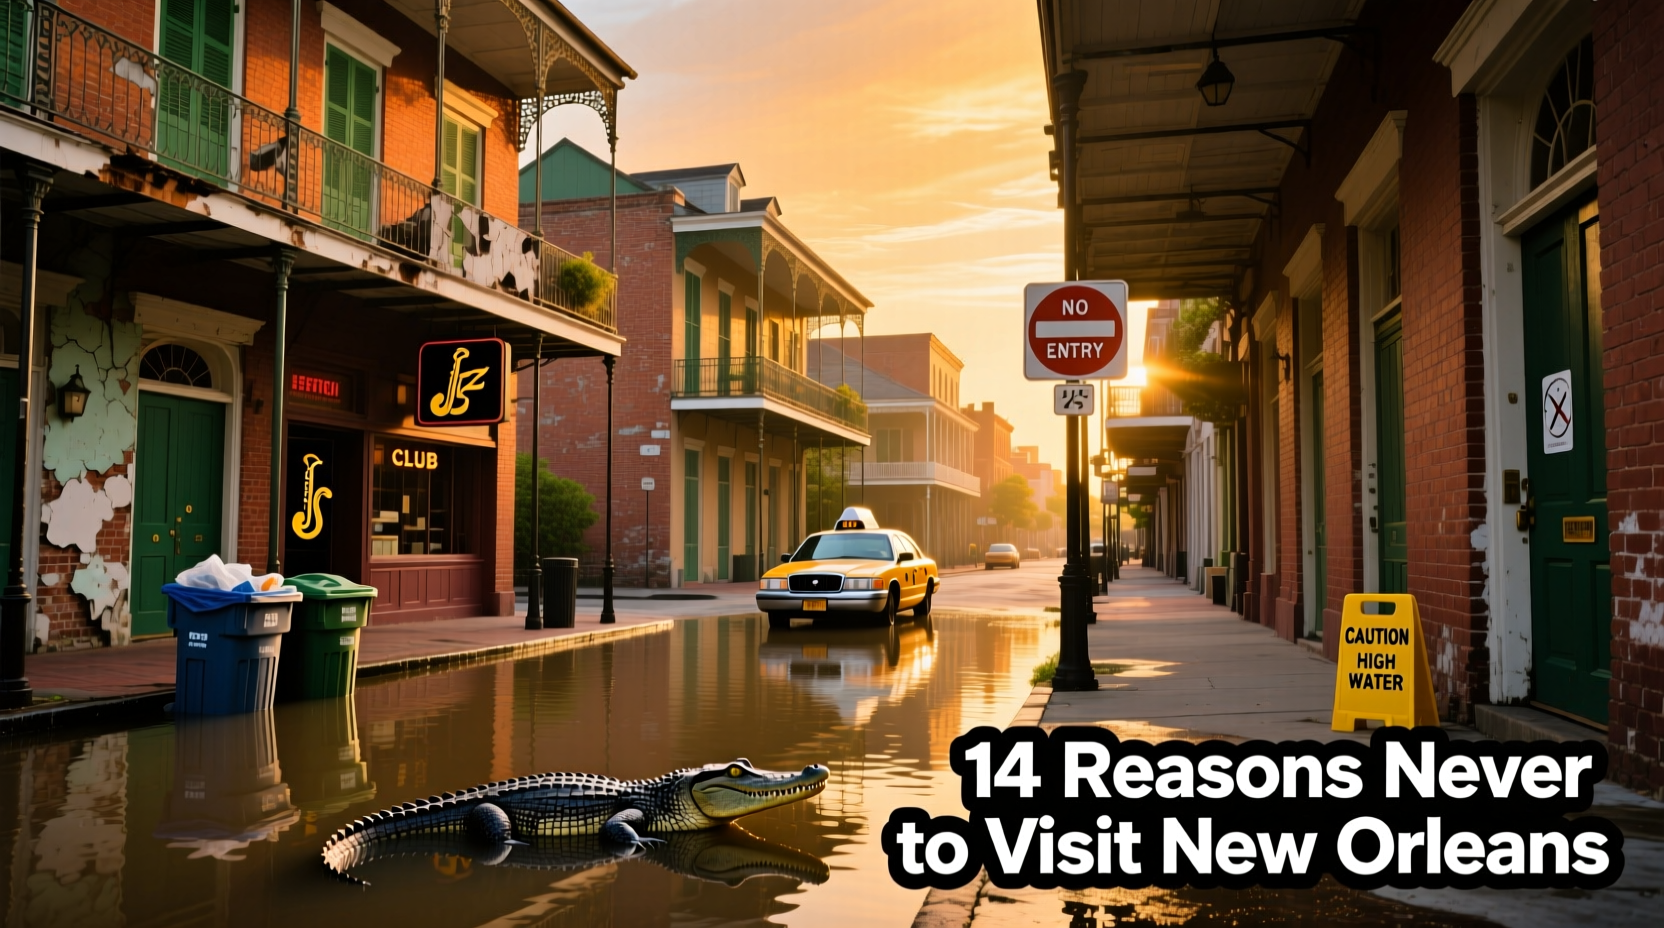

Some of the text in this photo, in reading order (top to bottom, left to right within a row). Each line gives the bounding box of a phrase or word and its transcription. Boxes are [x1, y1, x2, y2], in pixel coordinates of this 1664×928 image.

[1062, 299, 1089, 316] NO
[1047, 342, 1104, 359] ENTRY
[392, 448, 438, 470] CLUB
[1345, 627, 1409, 645] CAUTION
[1357, 653, 1396, 669] HIGH
[1349, 673, 1404, 691] WATER
